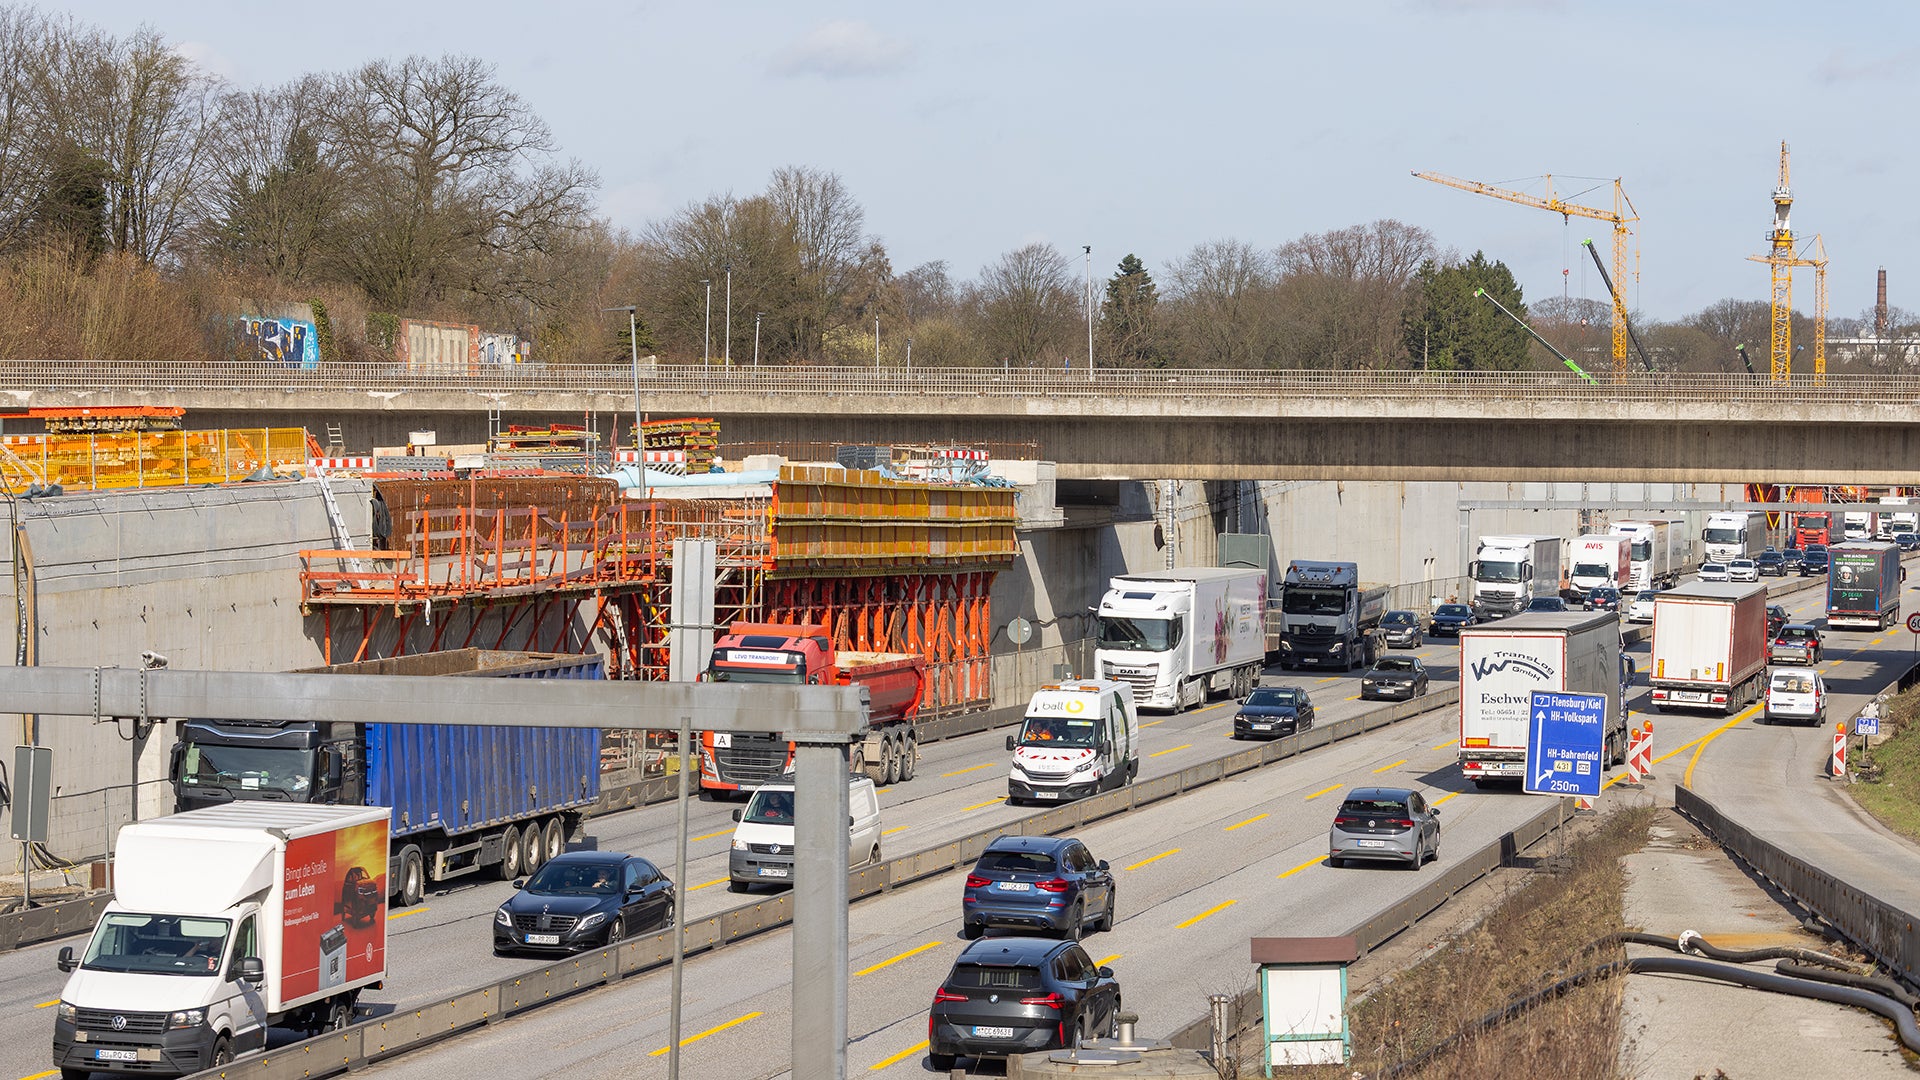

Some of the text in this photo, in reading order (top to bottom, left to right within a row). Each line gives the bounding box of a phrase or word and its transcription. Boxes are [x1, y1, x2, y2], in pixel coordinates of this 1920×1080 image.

[1494, 651, 1554, 675] TransLog
[1512, 666, 1541, 682] GmbH
[1042, 702, 1063, 710] ball
[1552, 696, 1602, 710] Flensburg/Kiel
[1551, 711, 1598, 725] HH-Volkspark
[718, 736, 726, 745] A
[1547, 748, 1598, 760] HH-Bahrenfeld
[1551, 780, 1579, 792] 250m
[286, 867, 302, 882] Bringt
[312, 860, 327, 875] Straße
[285, 883, 315, 900] zum Leben
